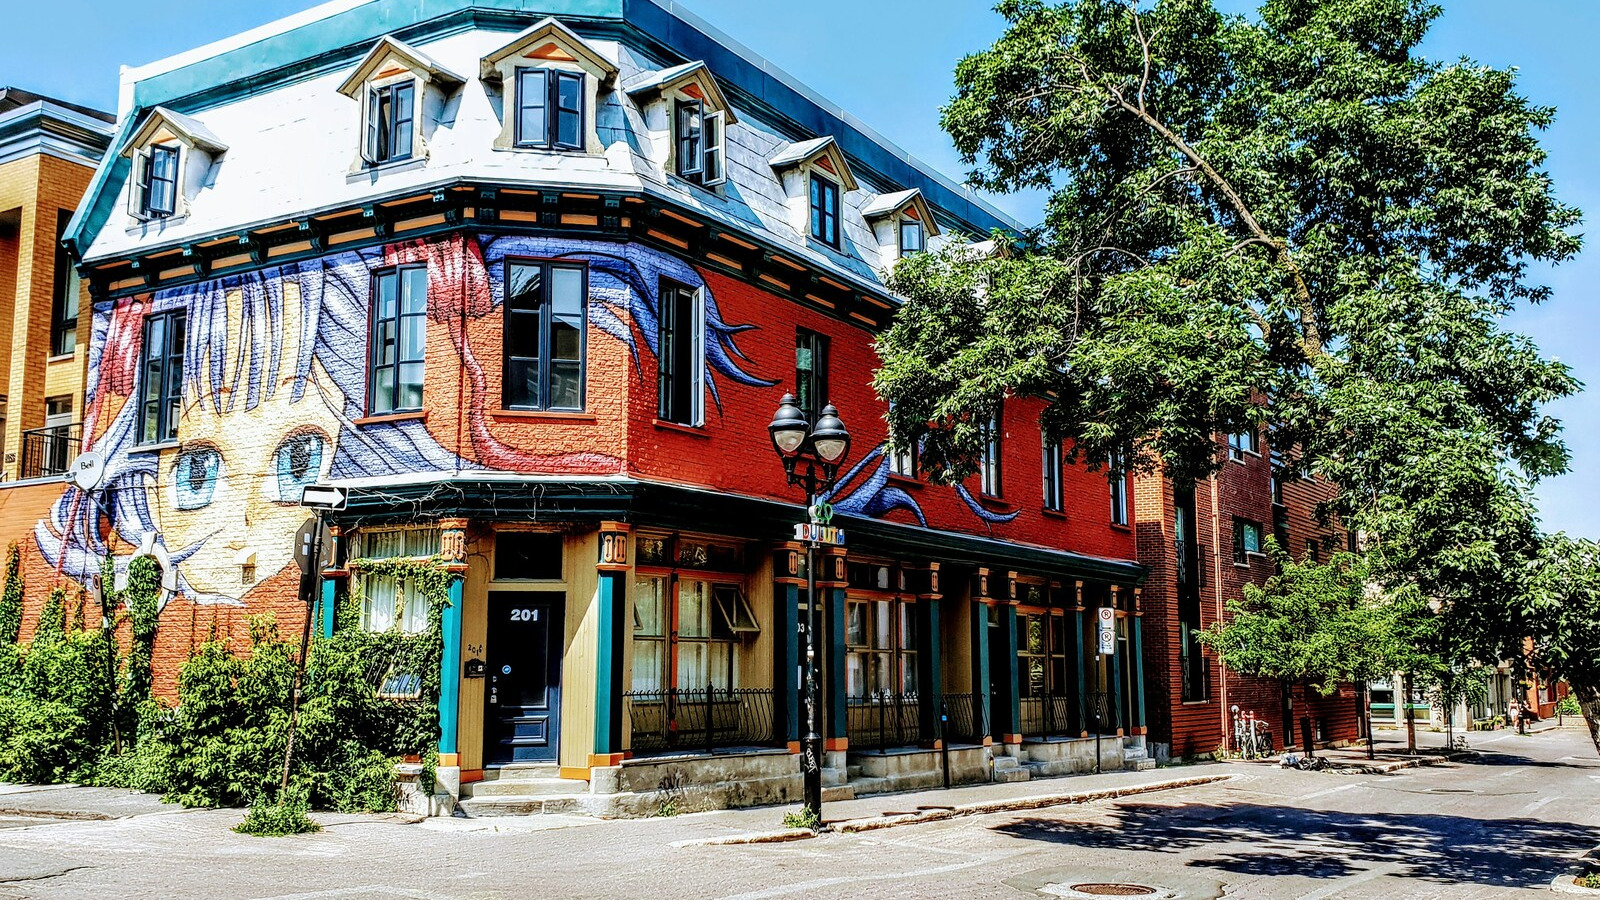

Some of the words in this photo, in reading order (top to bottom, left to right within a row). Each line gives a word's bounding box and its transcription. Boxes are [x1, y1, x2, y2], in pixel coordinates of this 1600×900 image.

[80, 459, 95, 470] Bell
[802, 523, 846, 545] DULUTH
[510, 608, 539, 622] 201
